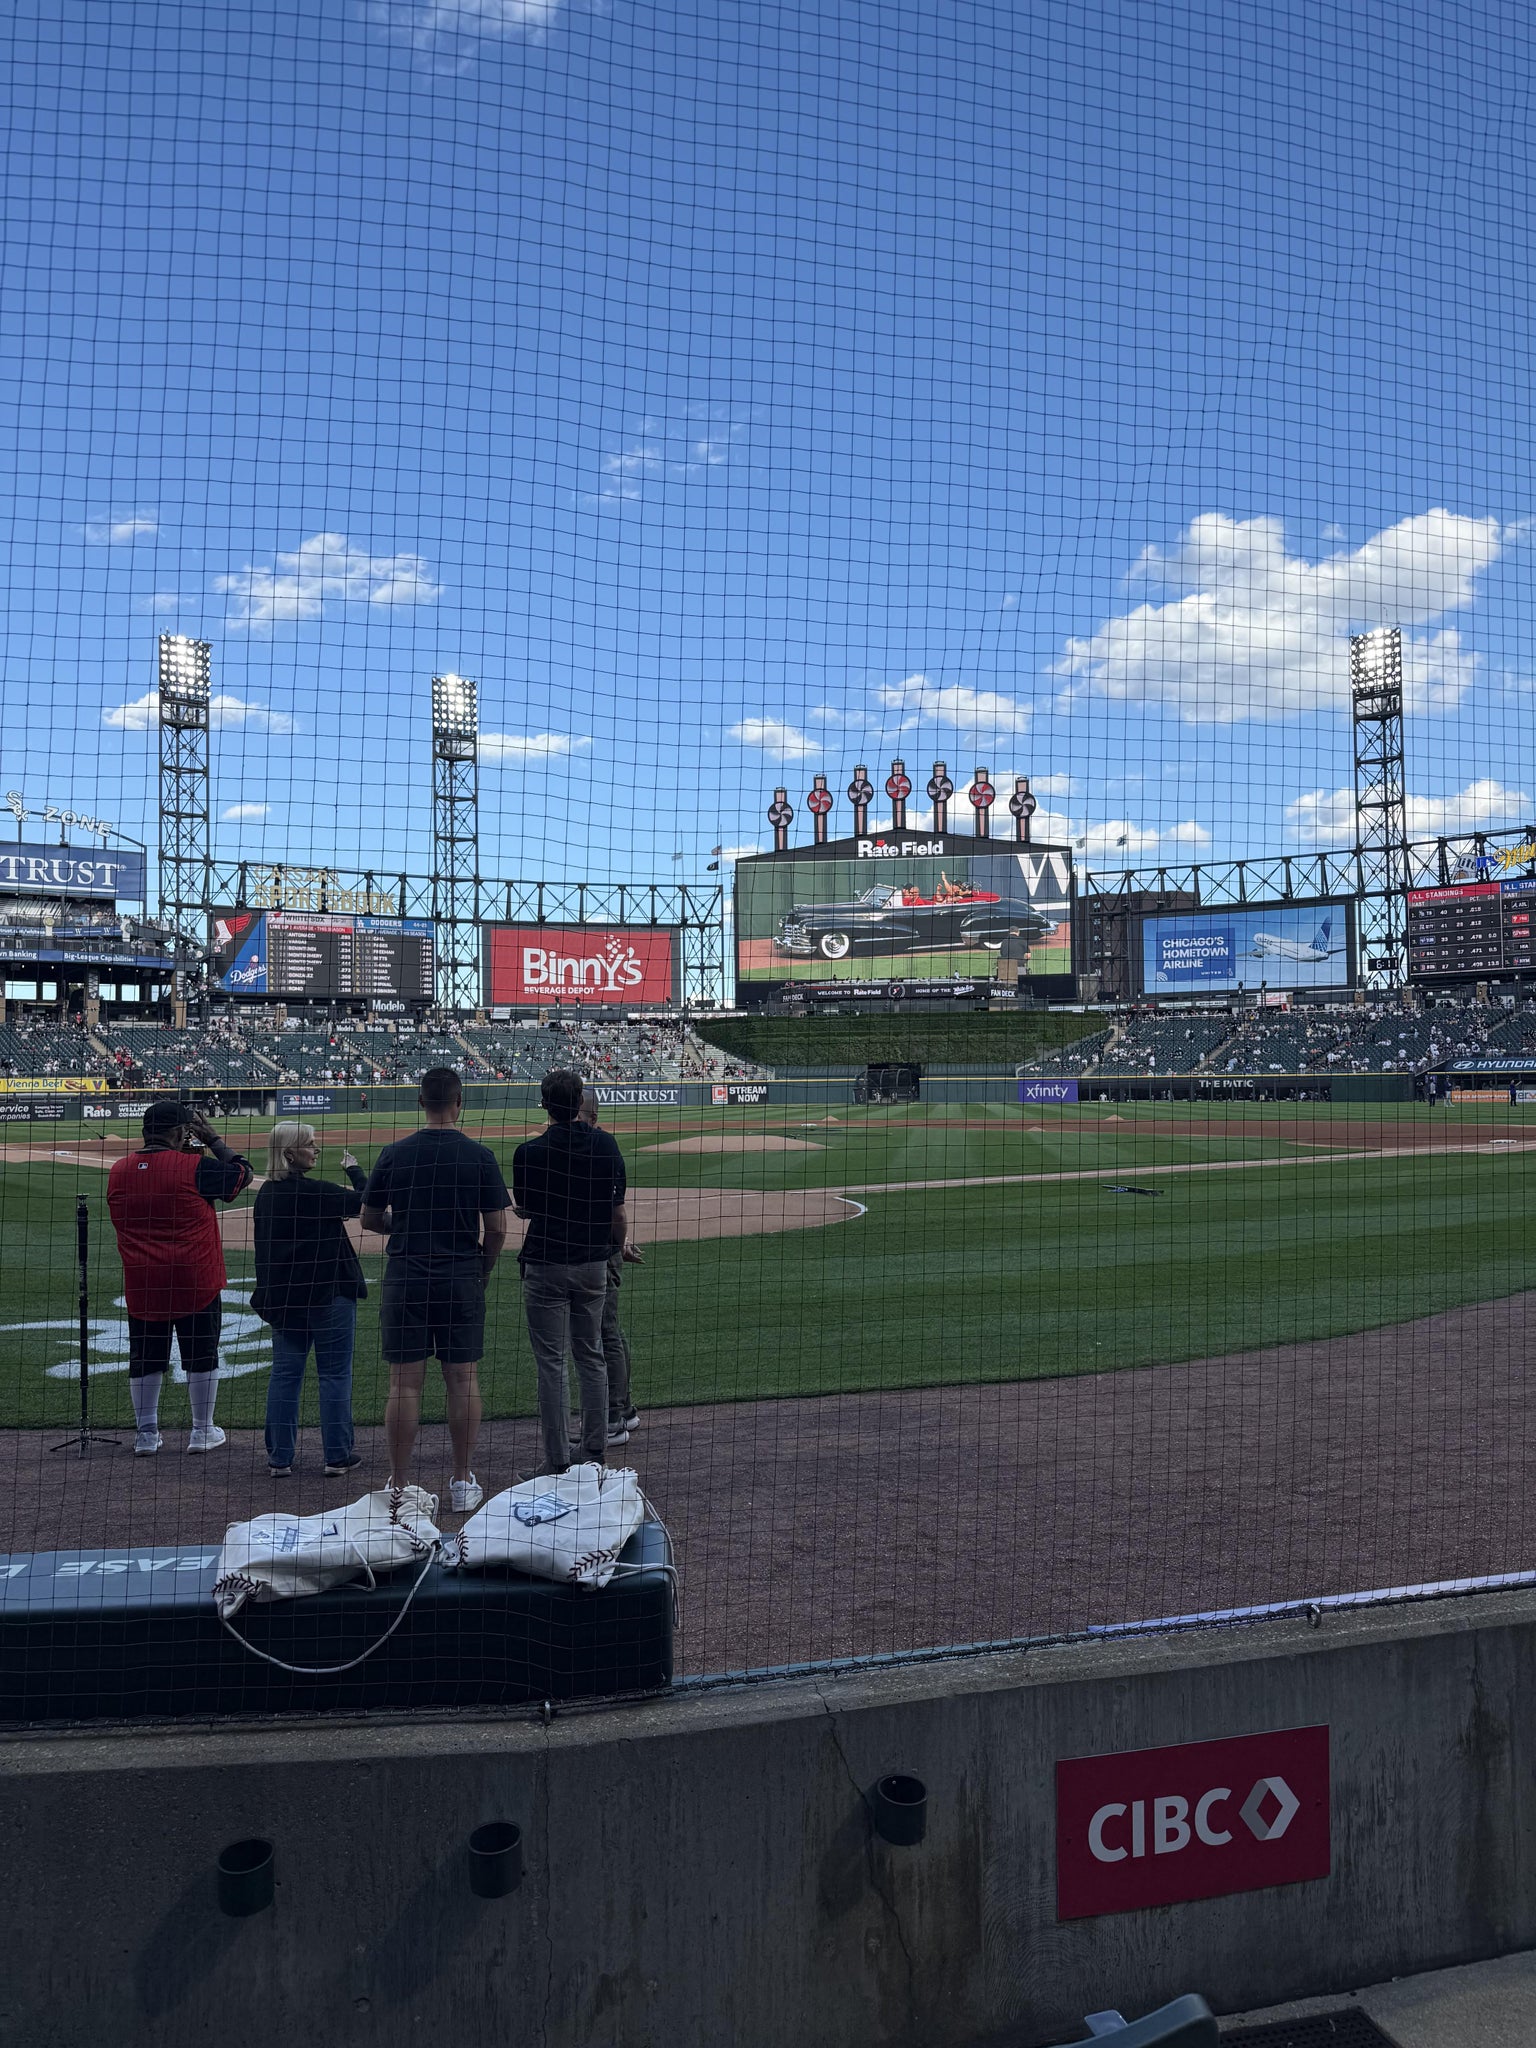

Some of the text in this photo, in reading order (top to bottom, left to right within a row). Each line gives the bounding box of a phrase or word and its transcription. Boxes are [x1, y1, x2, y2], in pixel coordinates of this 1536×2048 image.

[42, 805, 113, 838] ZONE
[858, 840, 944, 857] Rate Field
[254, 866, 339, 885] CAESARS
[254, 885, 395, 914] SPORTSBOOK
[1426, 889, 1464, 898] STANDINGS
[1162, 936, 1224, 948] CHICAGO'S
[9, 951, 37, 959] Banking
[64, 952, 134, 962] Big-League Capabilities
[1163, 947, 1228, 959] HOMETOWN
[524, 947, 642, 990] Binny's
[1163, 959, 1203, 969] AIRLINE
[1376, 960, 1398, 969] 6:11
[230, 964, 268, 983] Dodgers
[372, 1000, 405, 1012] Modelo
[7, 1080, 39, 1088] Vienna
[42, 1079, 63, 1087] Beef
[594, 1088, 678, 1102] WINTRUST
[729, 1086, 767, 1094] STREAM
[1027, 1084, 1068, 1099] xfinity
[84, 1105, 111, 1117] Rate
[1088, 1787, 1232, 1862] CIBC
